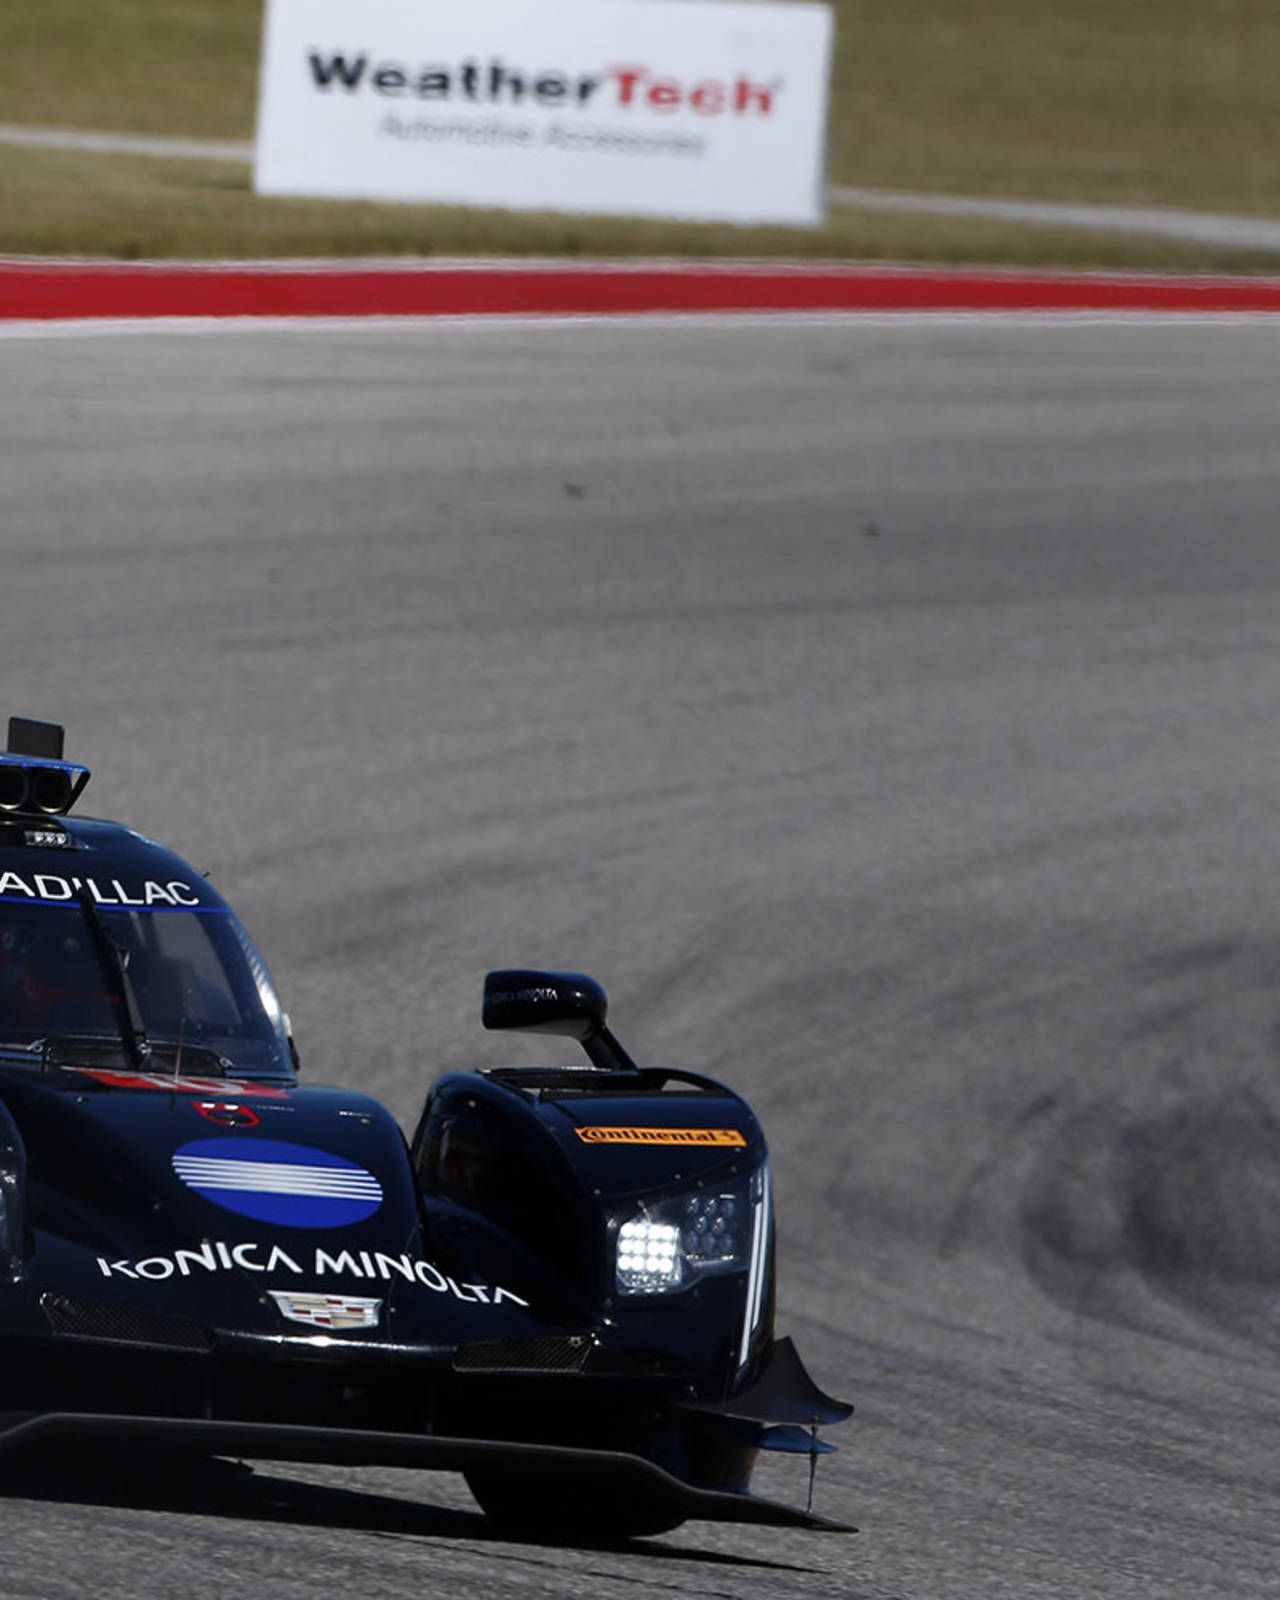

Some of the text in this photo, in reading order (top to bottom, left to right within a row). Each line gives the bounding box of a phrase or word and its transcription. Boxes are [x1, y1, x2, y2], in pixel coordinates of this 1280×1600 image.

[307, 49, 774, 116] WeatherTech
[378, 112, 531, 150] Automotive
[581, 1127, 717, 1142] Continental
[97, 1241, 530, 1307] KONICA MINOLTA
